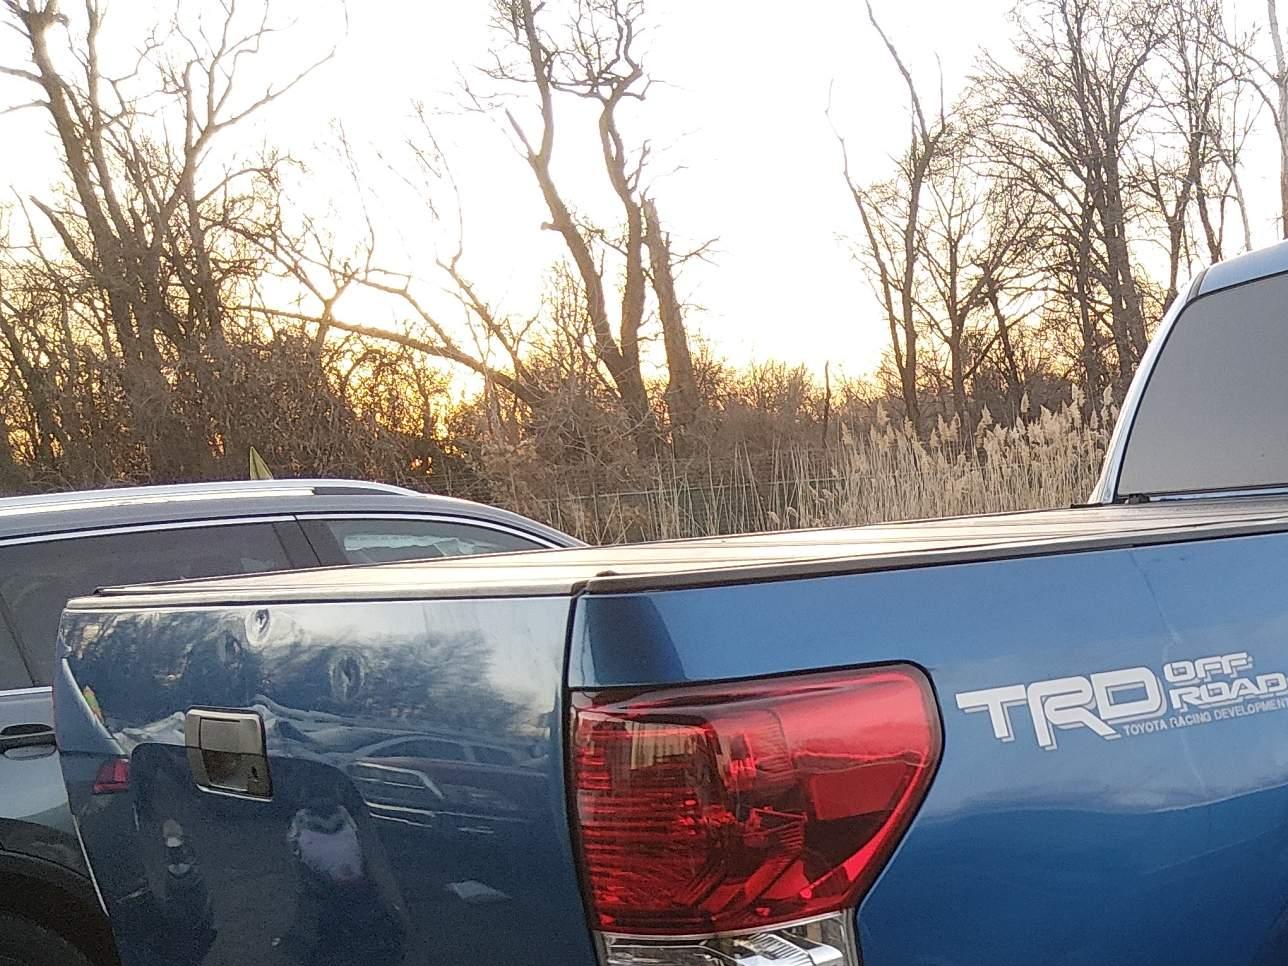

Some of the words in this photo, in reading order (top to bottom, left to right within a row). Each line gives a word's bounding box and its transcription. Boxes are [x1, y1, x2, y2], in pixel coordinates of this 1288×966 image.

[1163, 652, 1253, 684] OFF
[956, 666, 1167, 751] TRD
[1123, 719, 1168, 737] TOYOTA
[1169, 709, 1212, 729] RACING
